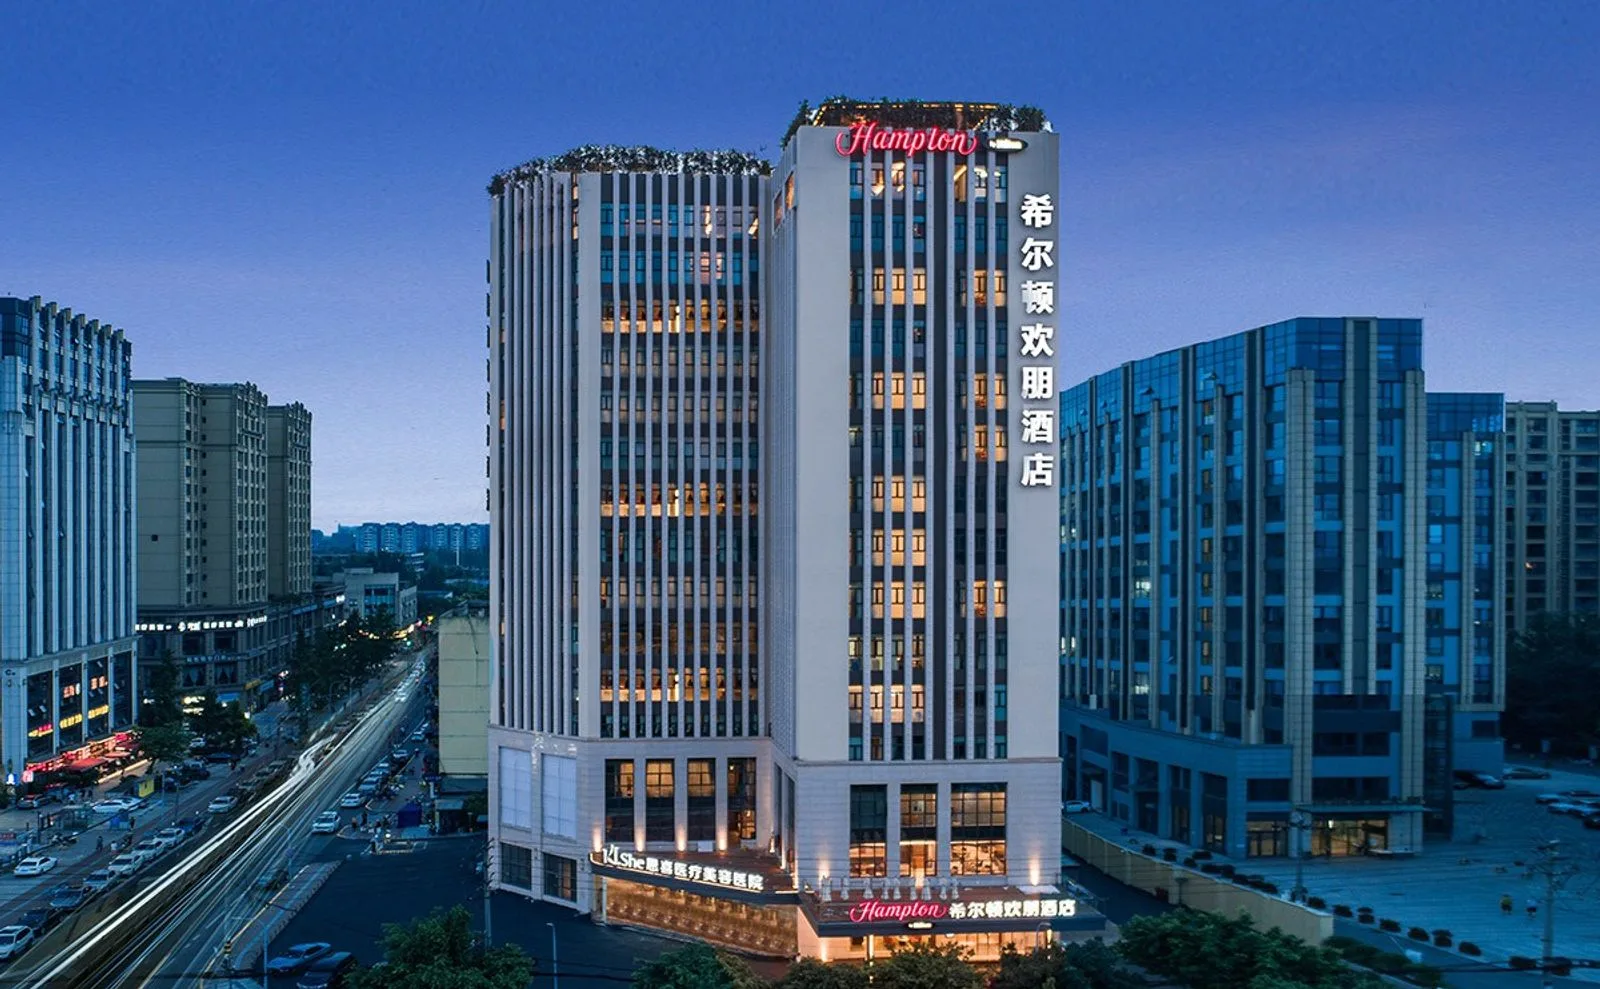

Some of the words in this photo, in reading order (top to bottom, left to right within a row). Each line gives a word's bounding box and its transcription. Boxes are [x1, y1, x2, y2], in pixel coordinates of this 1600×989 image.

[835, 122, 978, 157] Hampton
[1021, 194, 1054, 487] 希尔顿欢朋酒店
[849, 899, 948, 923] Hampton
[949, 899, 1076, 919] 希尔顿欢朋酒店
